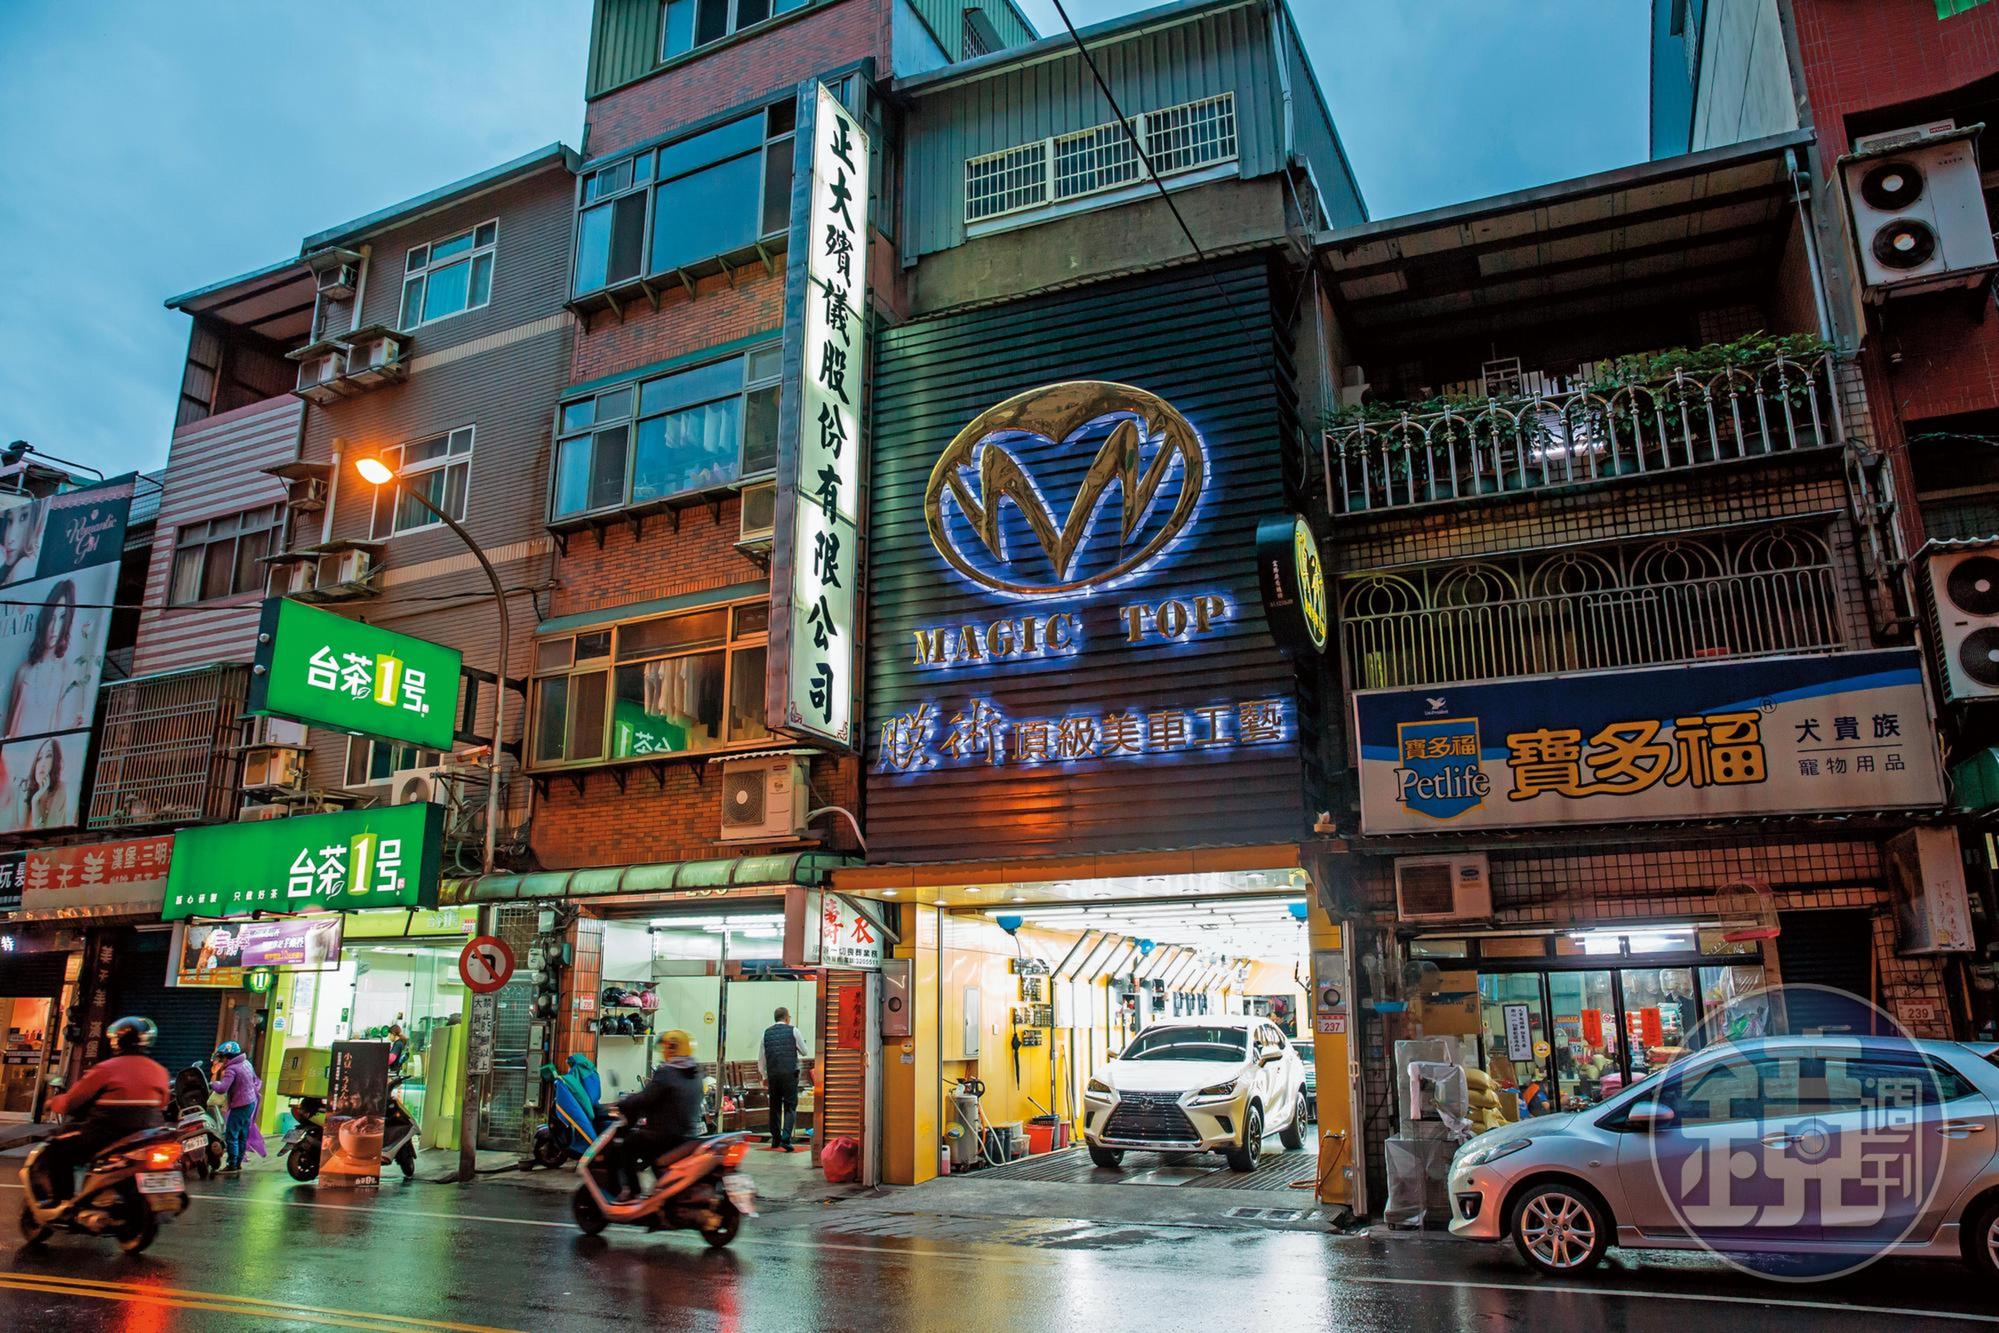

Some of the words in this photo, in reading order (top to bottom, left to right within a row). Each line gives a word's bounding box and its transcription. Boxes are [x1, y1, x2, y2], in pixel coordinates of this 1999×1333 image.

[806, 114, 857, 726] 正大殯儀股份有限公司
[913, 612, 1075, 665] MAGIC
[1120, 595, 1227, 643] TOP
[1794, 712, 1902, 744] 犬貴族
[1404, 734, 1477, 760] 寶多福
[1505, 710, 1768, 802] 寶多福
[1798, 752, 1906, 777] 寵物用品
[1393, 764, 1491, 802] Petlife
[823, 898, 875, 944] 壽衣
[1324, 1022, 1341, 1032] 237
[1907, 1008, 1929, 1019] 239
